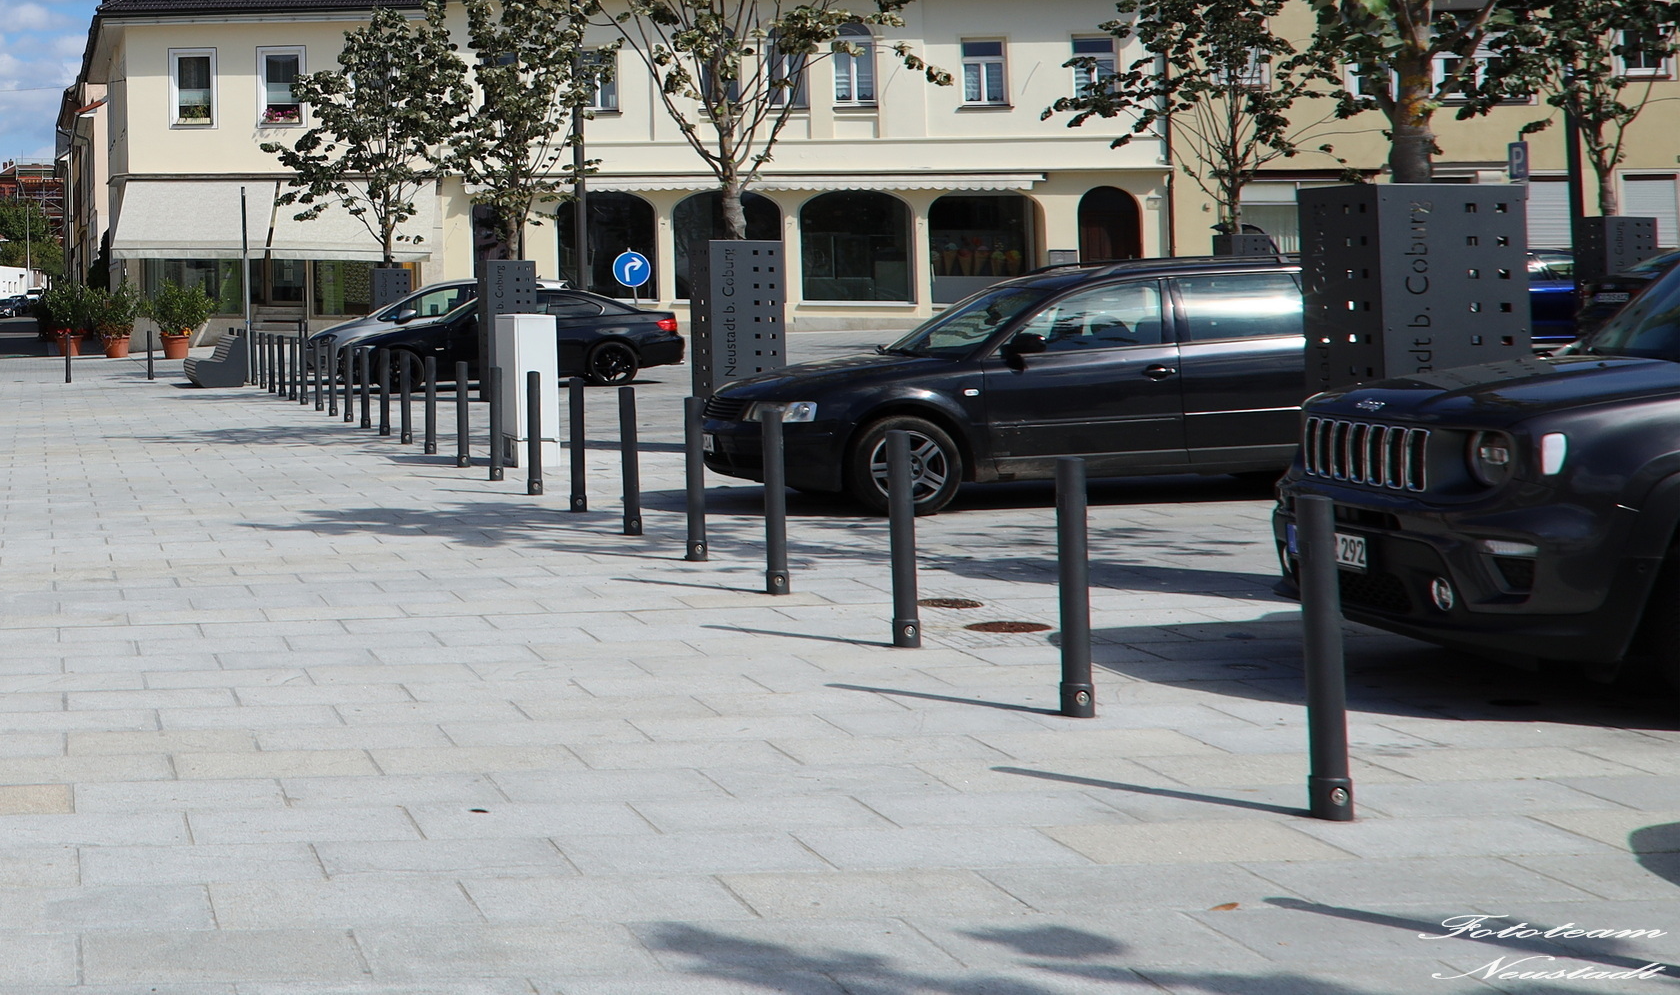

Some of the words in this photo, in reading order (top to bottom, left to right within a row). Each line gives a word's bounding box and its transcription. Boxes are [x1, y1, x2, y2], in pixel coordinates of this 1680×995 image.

[1512, 146, 1524, 175] P
[1405, 200, 1434, 295] Coburg
[494, 265, 506, 299] Coburg
[721, 248, 736, 297] Coburg
[723, 301, 736, 314] b.
[723, 317, 737, 377] Neustadt
[1341, 537, 1365, 565] 292
